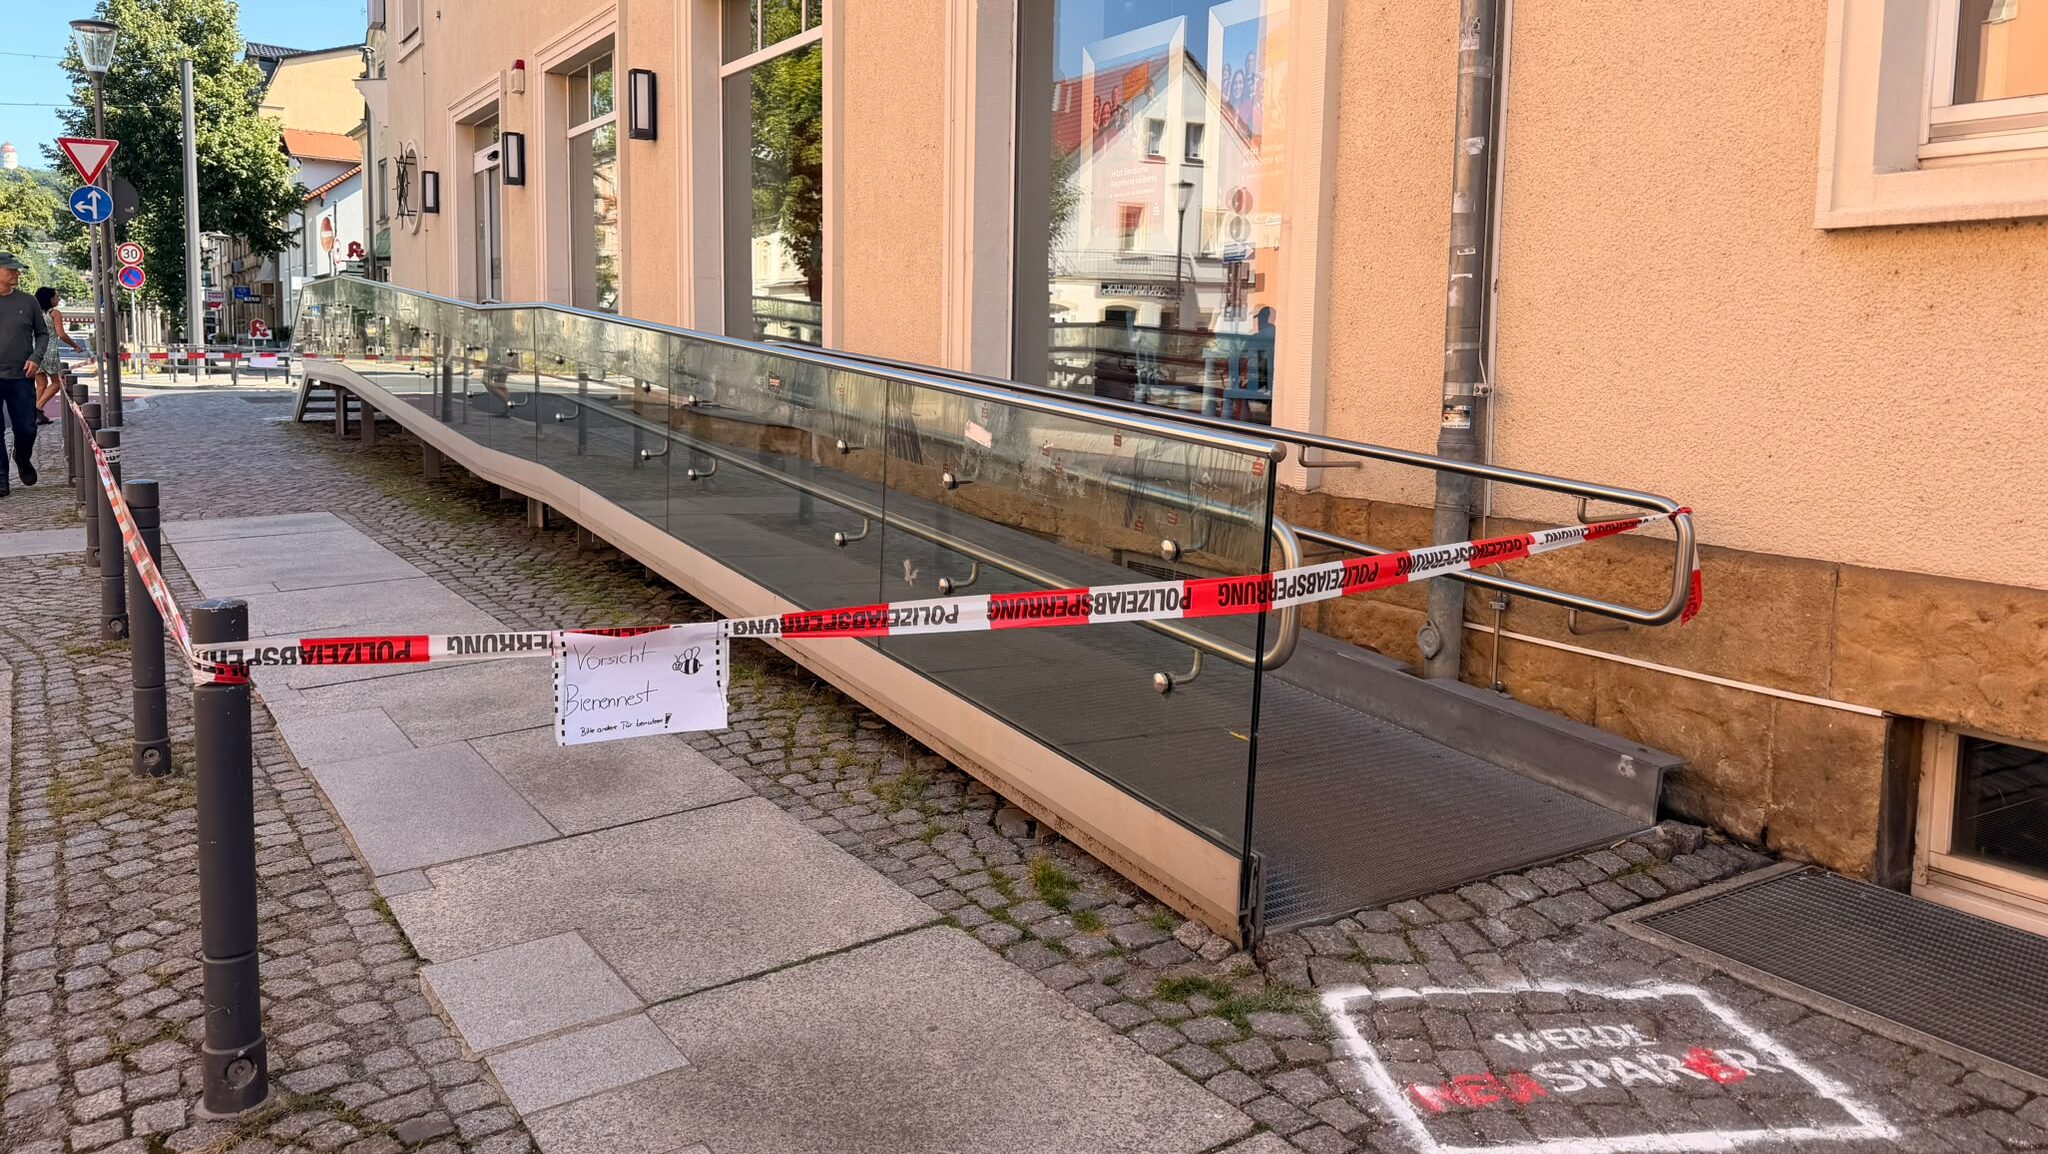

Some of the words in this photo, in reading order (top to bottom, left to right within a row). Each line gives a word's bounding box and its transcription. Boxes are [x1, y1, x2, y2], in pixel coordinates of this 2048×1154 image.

[122, 248, 138, 260] 30
[1217, 561, 1380, 607] POLIZEIABSPERRUNG
[986, 586, 1193, 621] POLIZEIABSPERRUNG
[733, 604, 960, 636] POLIZEIABSPERRUNG
[573, 641, 658, 671] Vorsicht
[564, 680, 659, 717] Bienennest
[620, 720, 633, 730] Tür
[1494, 1023, 1658, 1054] WERDE
